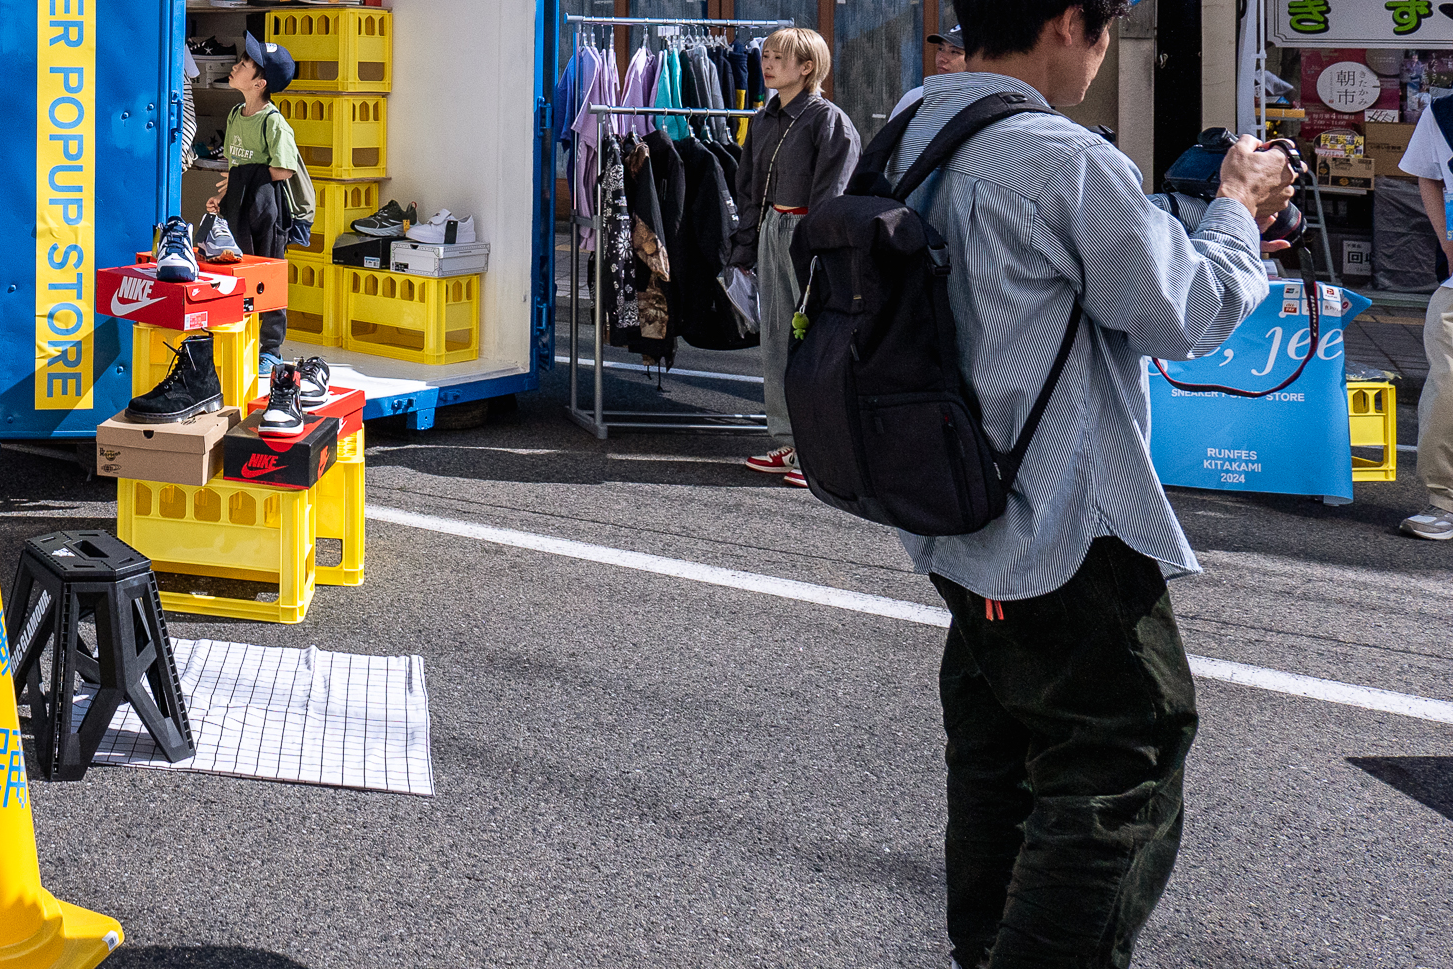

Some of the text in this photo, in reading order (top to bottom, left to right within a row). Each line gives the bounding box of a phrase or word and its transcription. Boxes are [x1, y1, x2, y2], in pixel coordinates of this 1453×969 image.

[1336, 70, 1356, 105] 朝市
[48, 66, 86, 227] POPUP
[118, 276, 154, 301] NIKE
[46, 243, 85, 399] STORE
[1266, 392, 1305, 402] STORE
[248, 453, 279, 469] NIKE
[1207, 448, 1257, 460] RUNFES
[1203, 459, 1262, 472] KITAKAMI
[1220, 473, 1245, 483] 2024
